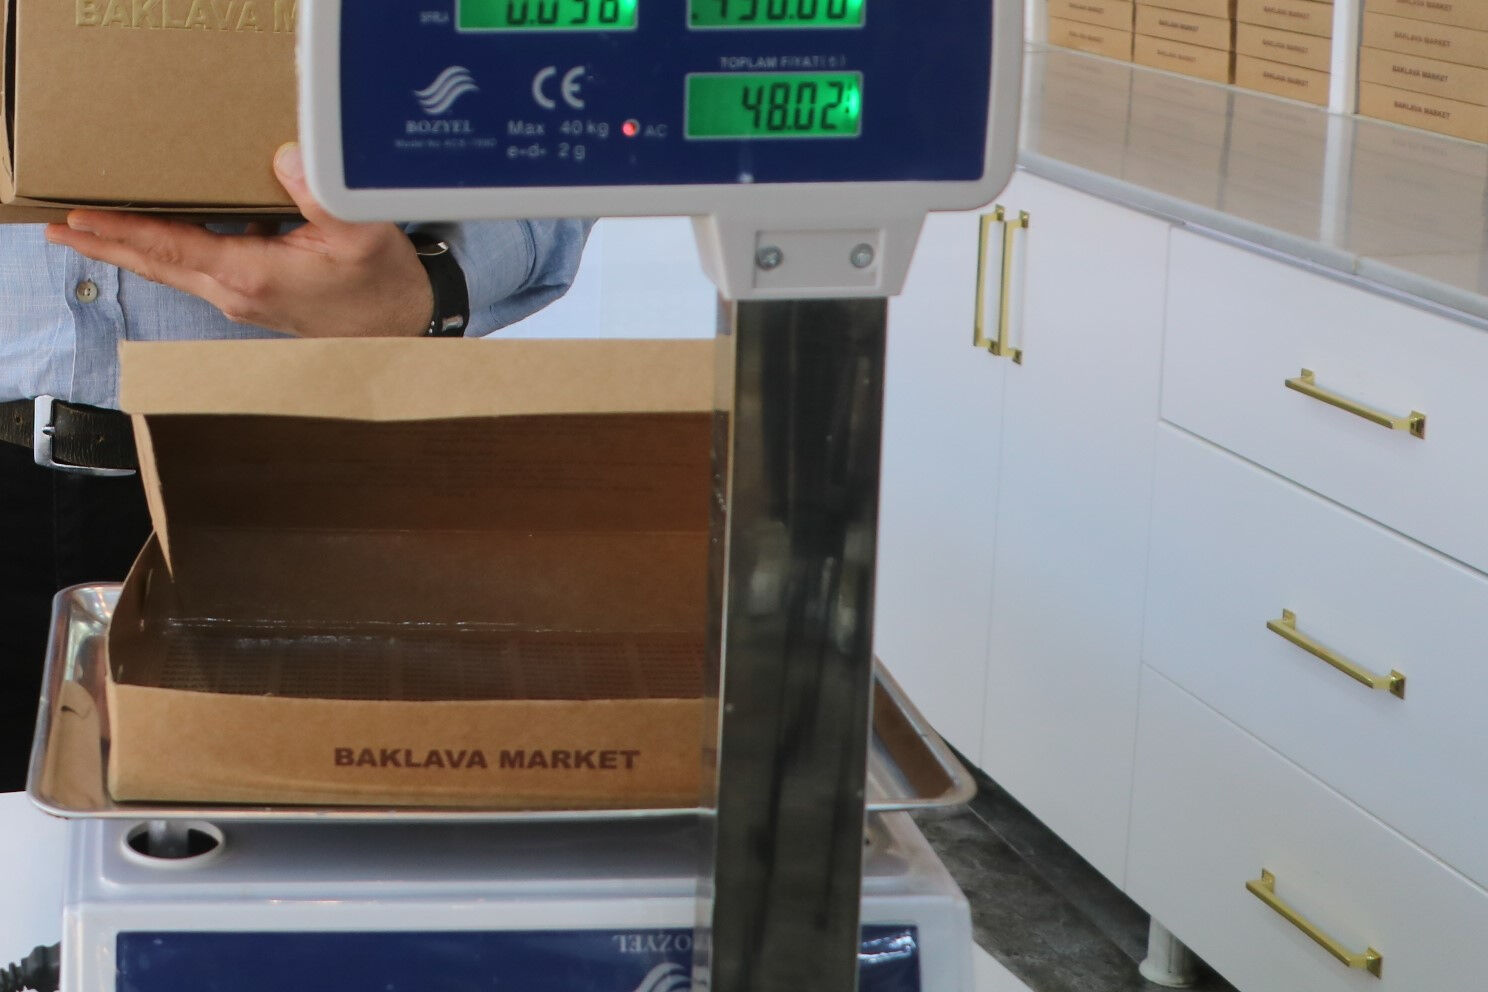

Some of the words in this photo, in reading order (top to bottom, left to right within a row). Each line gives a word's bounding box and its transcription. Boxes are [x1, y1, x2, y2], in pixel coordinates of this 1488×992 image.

[741, 81, 844, 130] 48.02
[406, 119, 473, 134] BOZYEL
[508, 119, 545, 135] Max
[560, 119, 583, 135] 40
[587, 119, 609, 139] kg
[645, 125, 668, 137] AC
[559, 142, 570, 157] 2
[334, 748, 488, 769] BAKLAVA
[499, 750, 641, 770] MARKET
[611, 934, 693, 953] OZYEL
